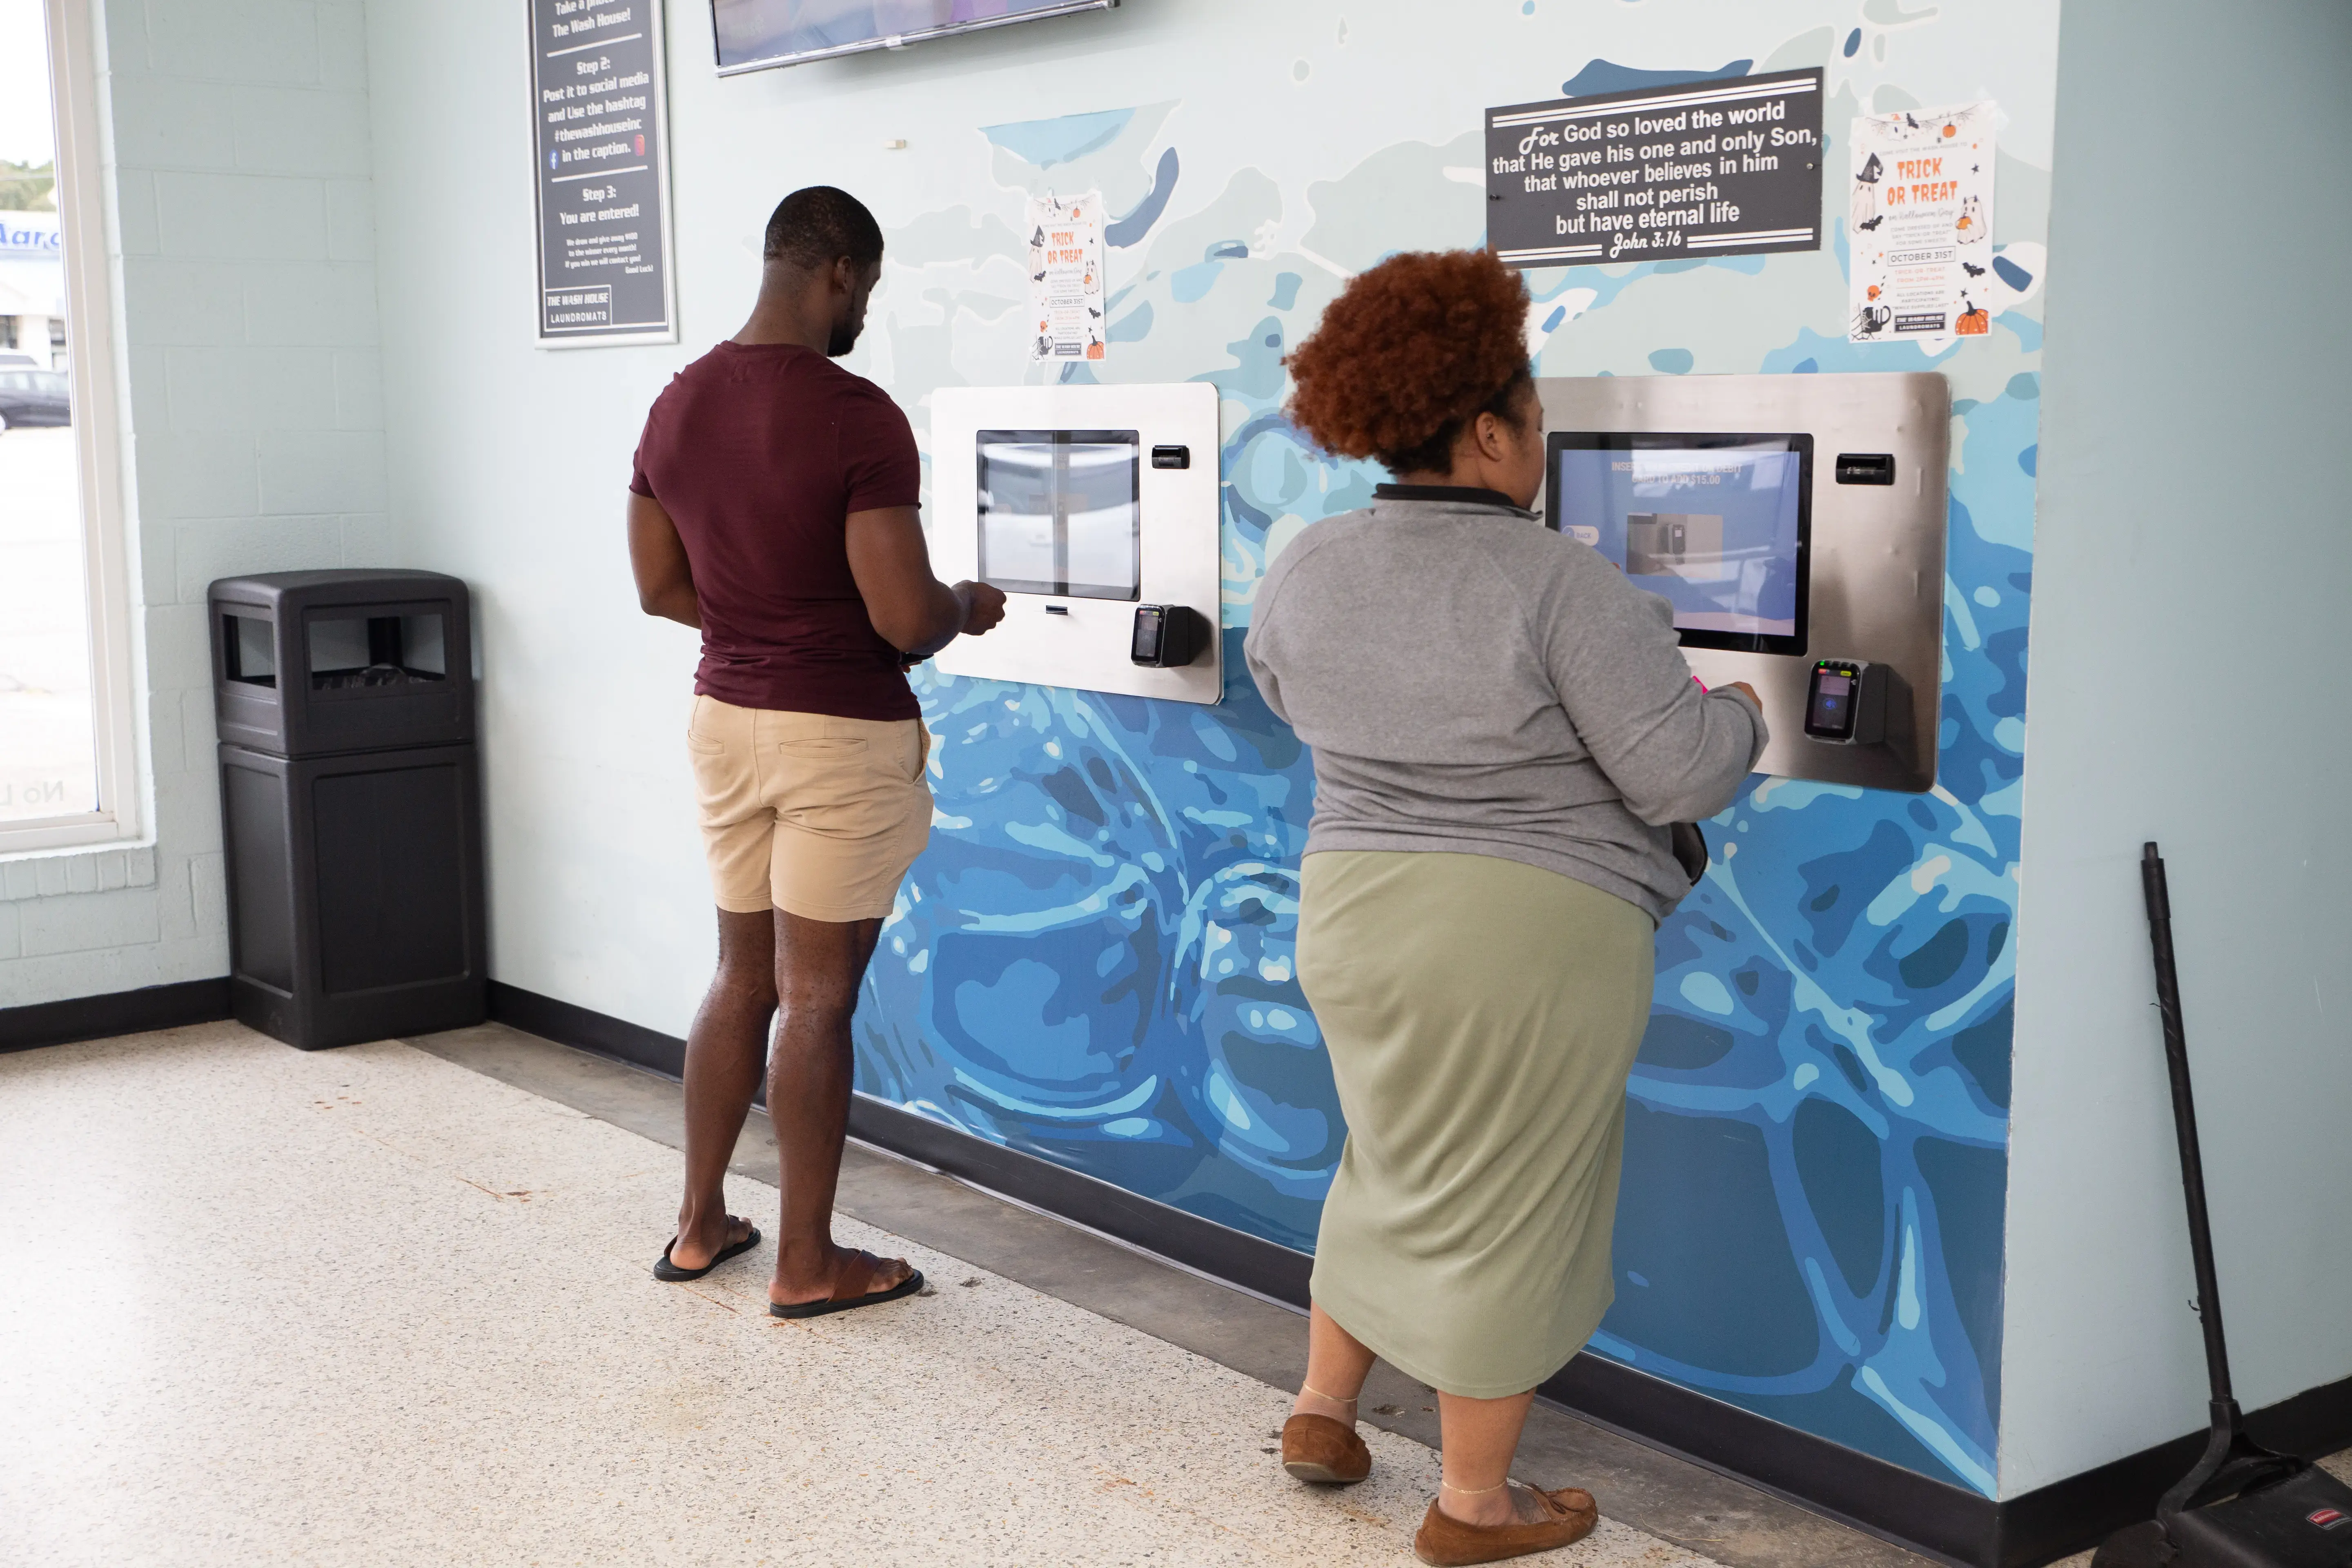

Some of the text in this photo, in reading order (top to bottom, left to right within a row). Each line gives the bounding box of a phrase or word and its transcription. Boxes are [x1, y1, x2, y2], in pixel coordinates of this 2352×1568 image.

[555, 1, 577, 16] Take
[578, 0, 585, 10] a
[552, 7, 631, 38] The Wash House!
[577, 56, 610, 75] Step 2:
[543, 72, 649, 102] Post it to social media
[548, 96, 646, 122] and Use the hashtag
[555, 118, 642, 142] #thewashhouseinc
[1519, 100, 1786, 155] For God so loved the world
[562, 149, 572, 163] in
[573, 147, 590, 161] the
[592, 142, 631, 159] caption.
[1492, 127, 1817, 174] that He gave his one and only Son,
[1524, 152, 1779, 193] that whoever believes in him
[1897, 157, 1943, 180] TRICK
[583, 185, 617, 203] Step 3:
[1576, 182, 1718, 211] shall not perish
[1887, 180, 1958, 206] OR TREAT
[559, 204, 639, 225] You are entered!
[1556, 202, 1741, 235] but have eternal life
[585, 247, 602, 256] winner
[603, 246, 618, 254] every
[618, 243, 637, 252] month!
[599, 236, 610, 245] give
[1051, 231, 1074, 247] TRICK
[1609, 230, 1682, 259] John 3:16
[570, 261, 580, 269] you
[599, 257, 608, 265] will
[609, 256, 628, 264] contact
[629, 254, 641, 264] you!
[1047, 248, 1083, 265] OR TREAT
[1891, 250, 1953, 262] OCTOBER 31ST
[625, 265, 654, 274] Good Luck!
[547, 292, 609, 307] THE WASH HOUSE
[550, 311, 607, 323] LAUNDROMATS
[1691, 475, 1721, 485] $15.00
